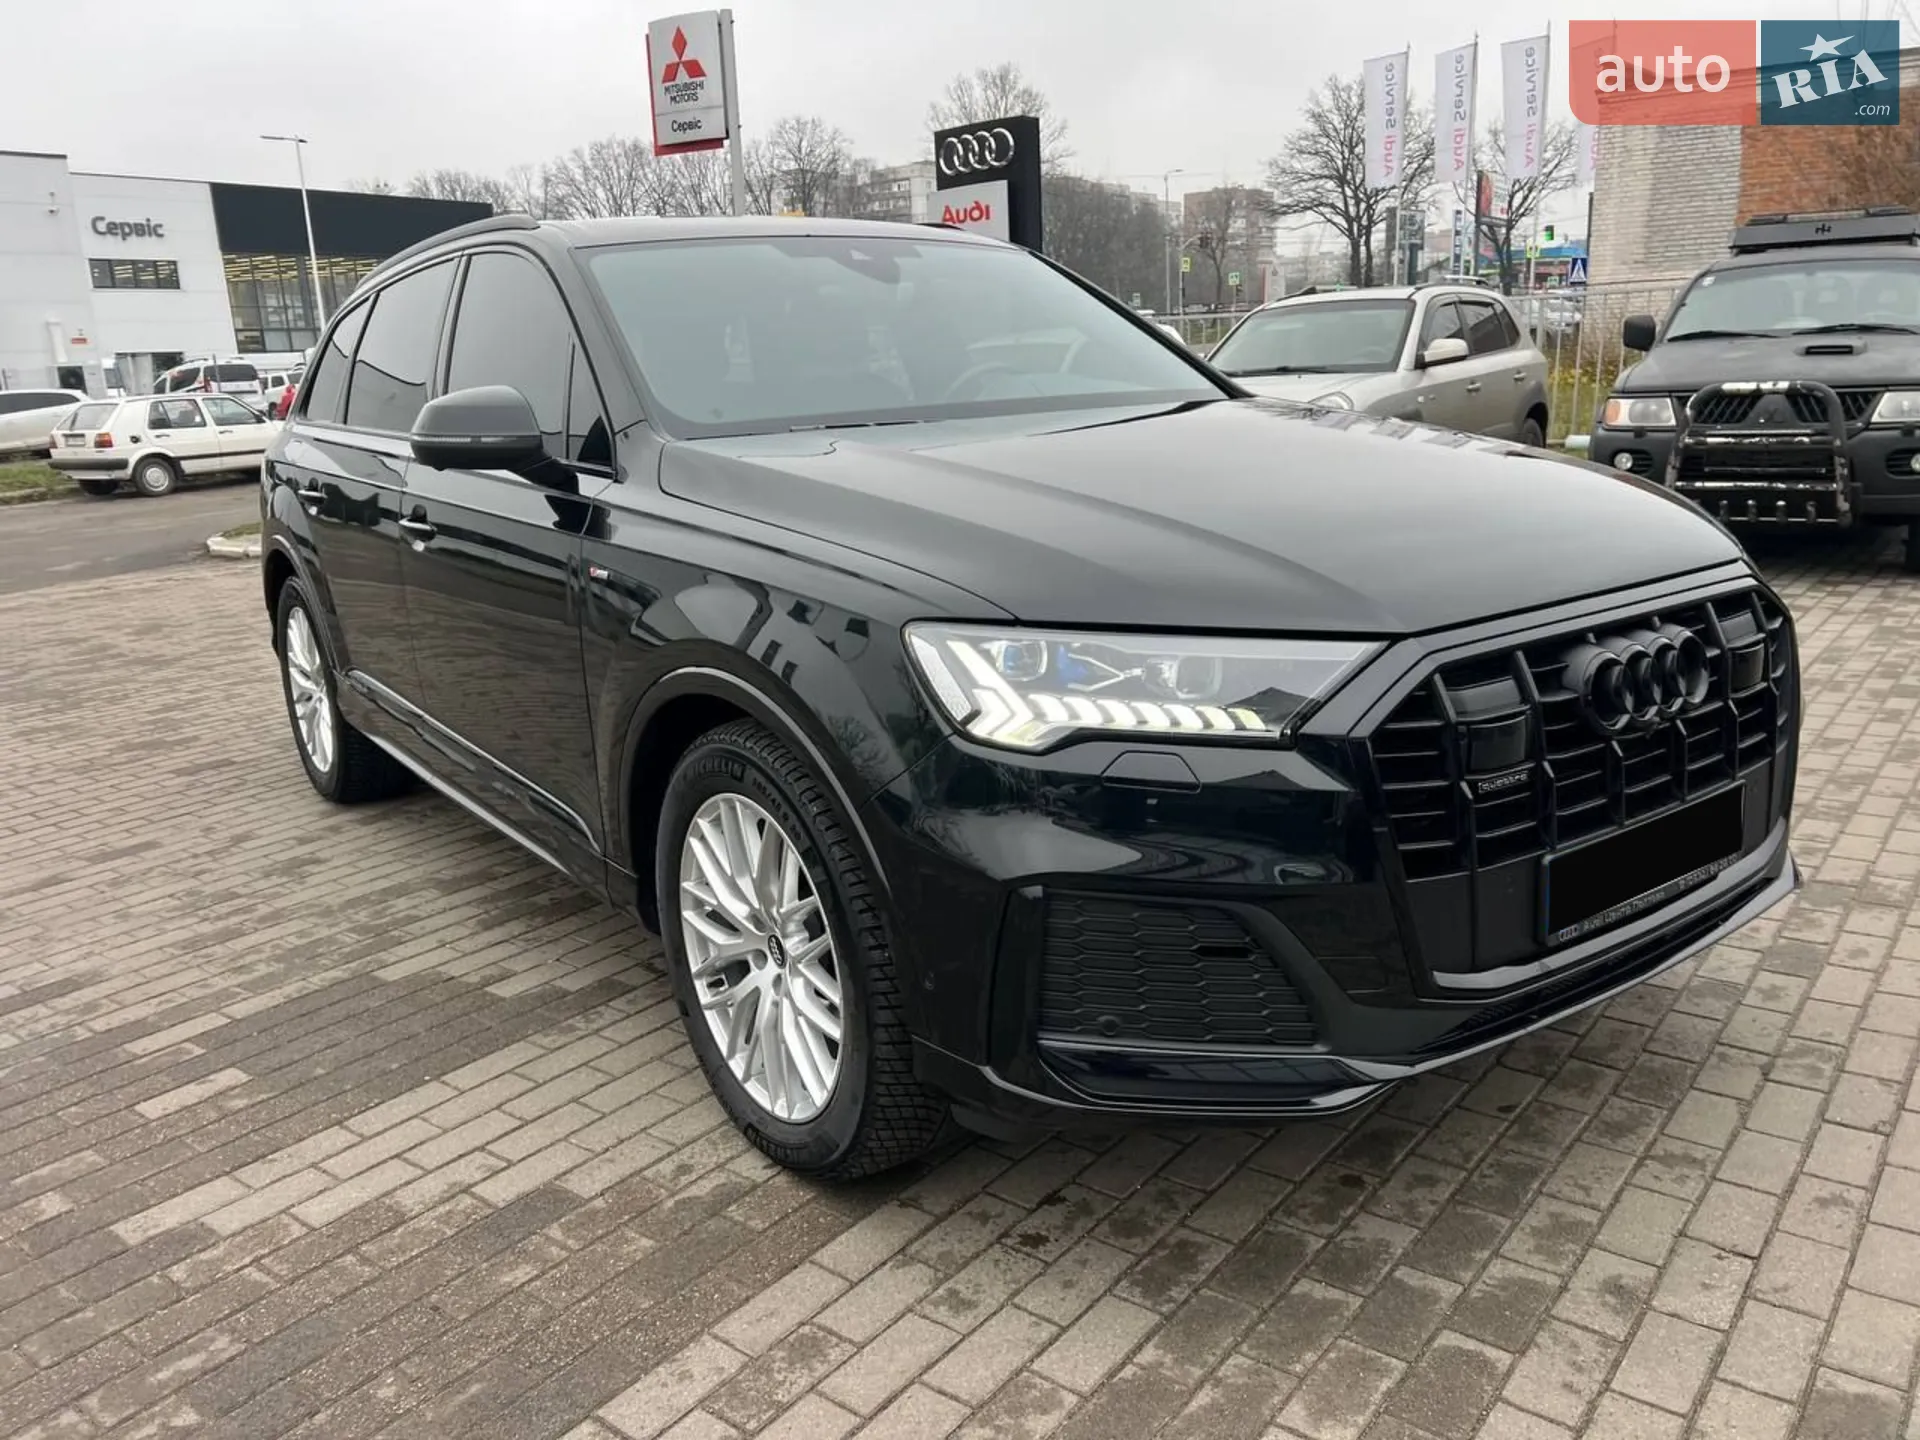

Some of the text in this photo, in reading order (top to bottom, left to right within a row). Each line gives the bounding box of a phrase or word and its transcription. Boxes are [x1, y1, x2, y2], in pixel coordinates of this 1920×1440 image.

[664, 80, 704, 95] MITSUBISHI
[670, 92, 699, 105] MOTORS
[671, 116, 702, 134] Сервіс
[942, 200, 990, 224] Audi
[91, 216, 164, 240] Сервіс
